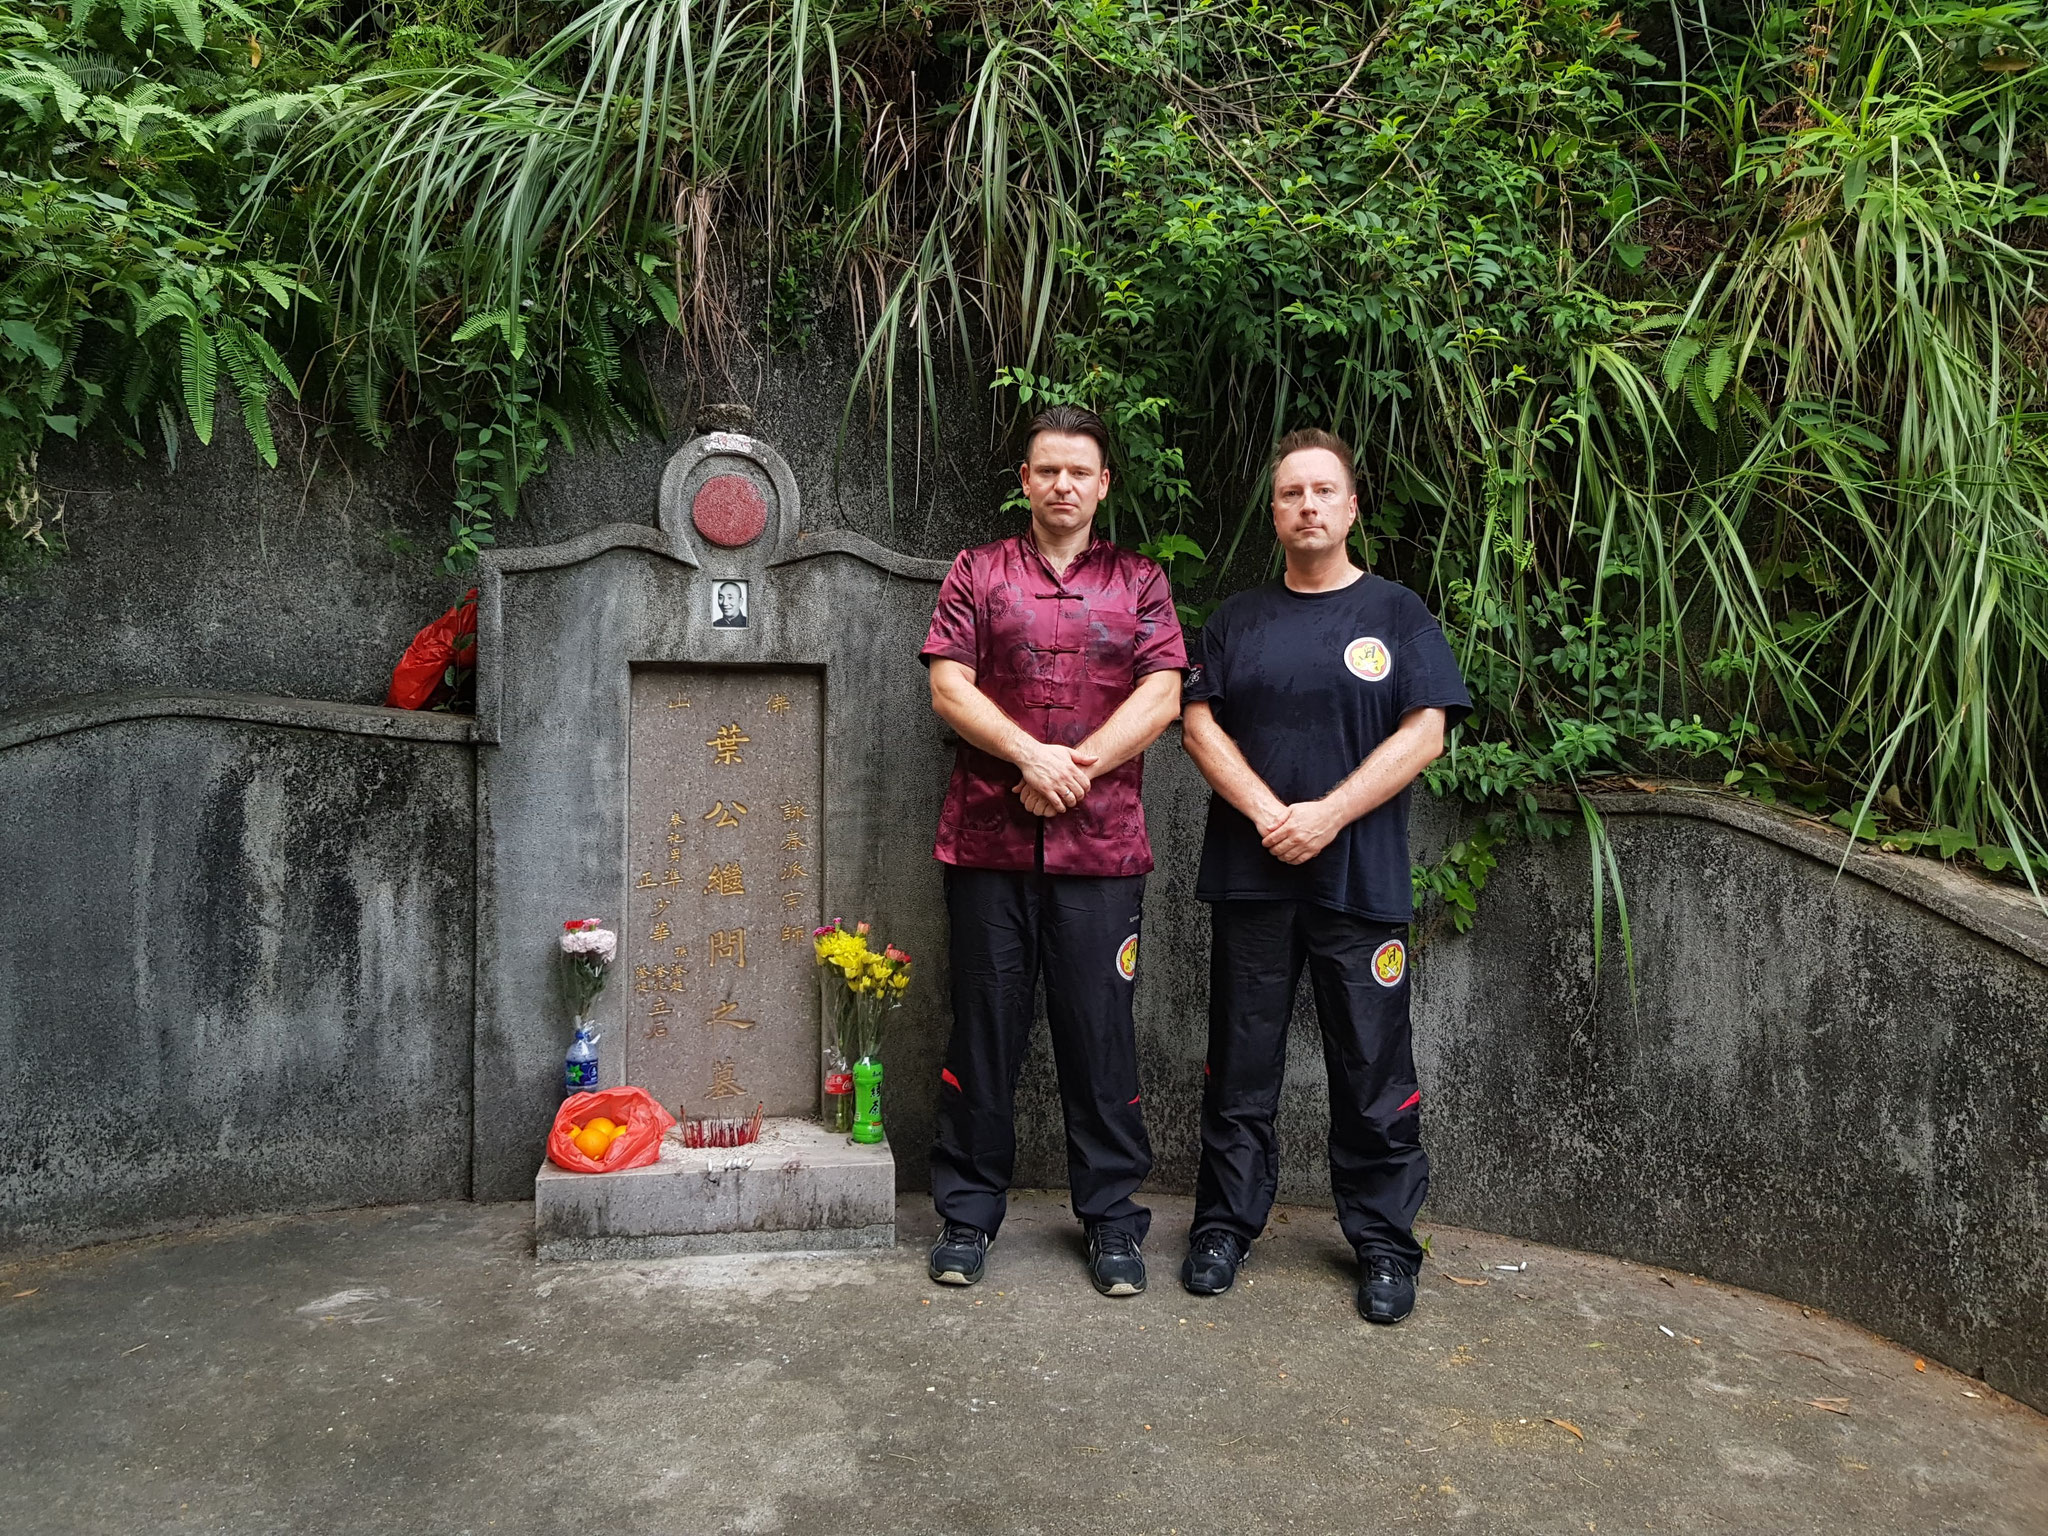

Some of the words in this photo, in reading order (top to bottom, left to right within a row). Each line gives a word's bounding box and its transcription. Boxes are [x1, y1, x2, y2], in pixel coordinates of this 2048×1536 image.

[668, 691, 691, 709] 山
[765, 692, 791, 718] 佛
[703, 723, 754, 1100] 葉公繼問之墓
[780, 799, 809, 949] 詠春派宗師
